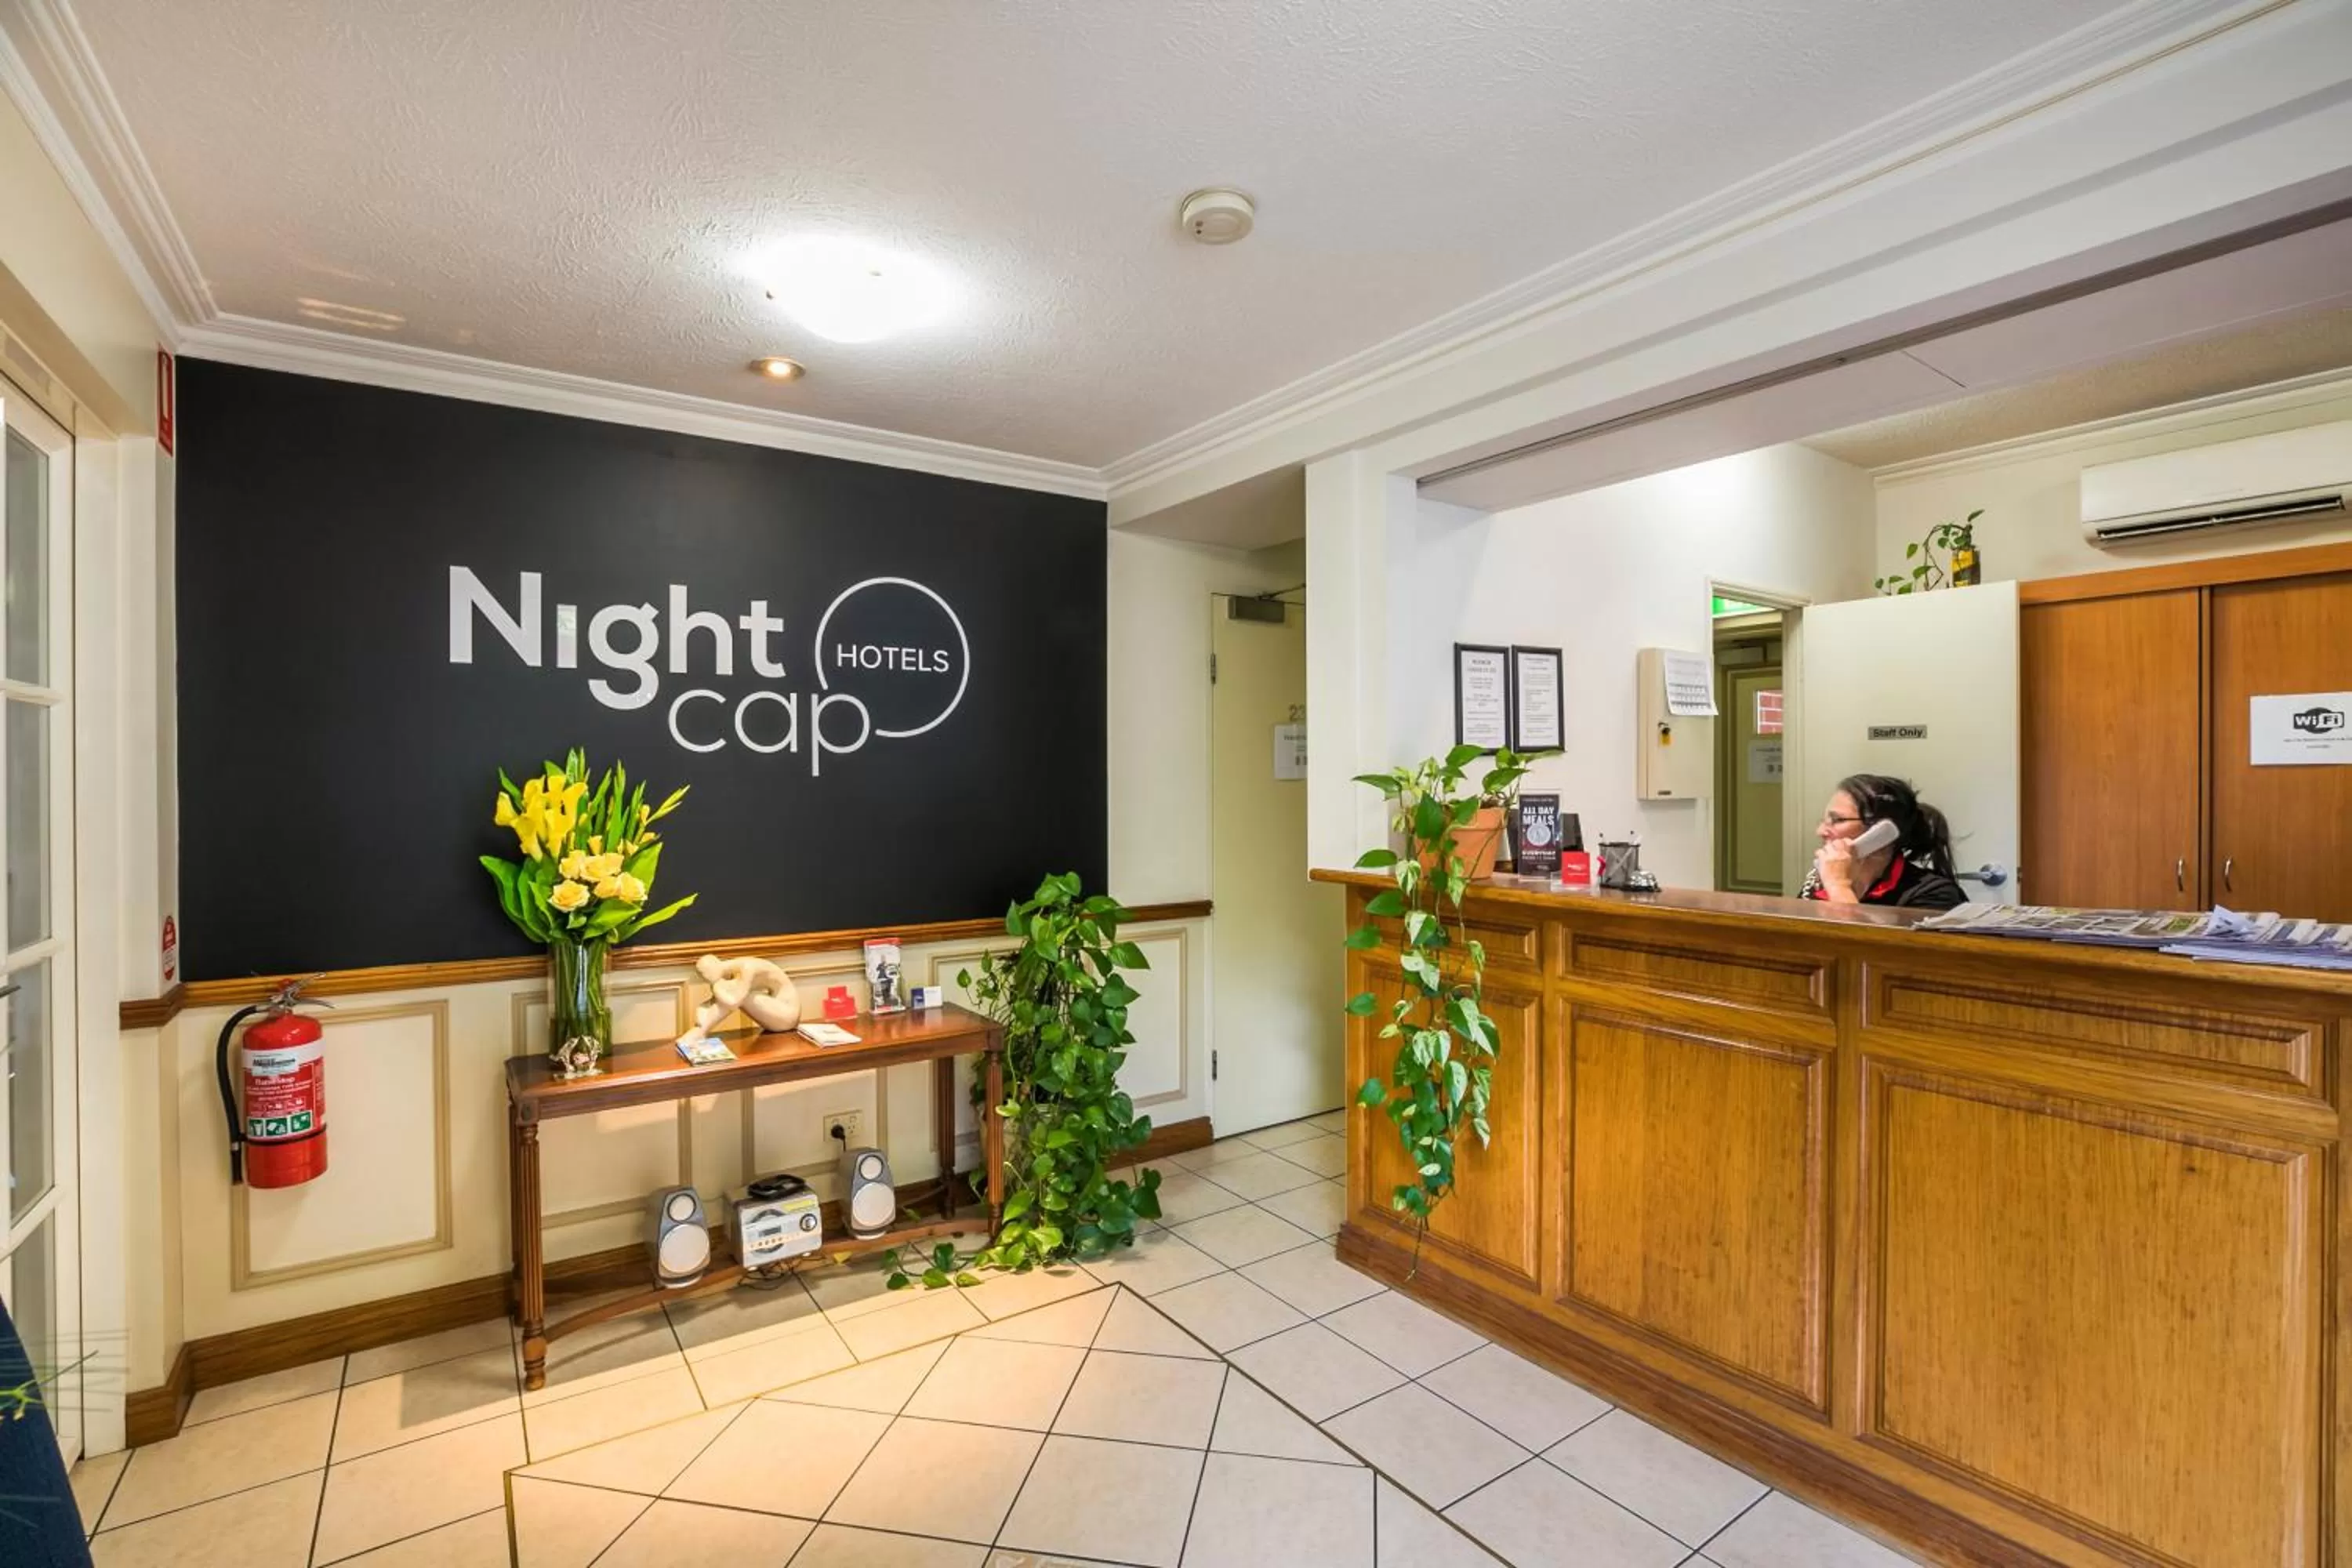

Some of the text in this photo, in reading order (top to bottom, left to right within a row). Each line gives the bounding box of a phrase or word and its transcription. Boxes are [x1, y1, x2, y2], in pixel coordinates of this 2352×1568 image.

[449, 564, 787, 710] Night
[836, 643, 950, 673] HOTELS
[668, 688, 871, 777] cap
[1873, 727, 1923, 739] Staff Only
[1522, 806, 1555, 815] ALL DAY
[1522, 815, 1555, 826] MEALS
